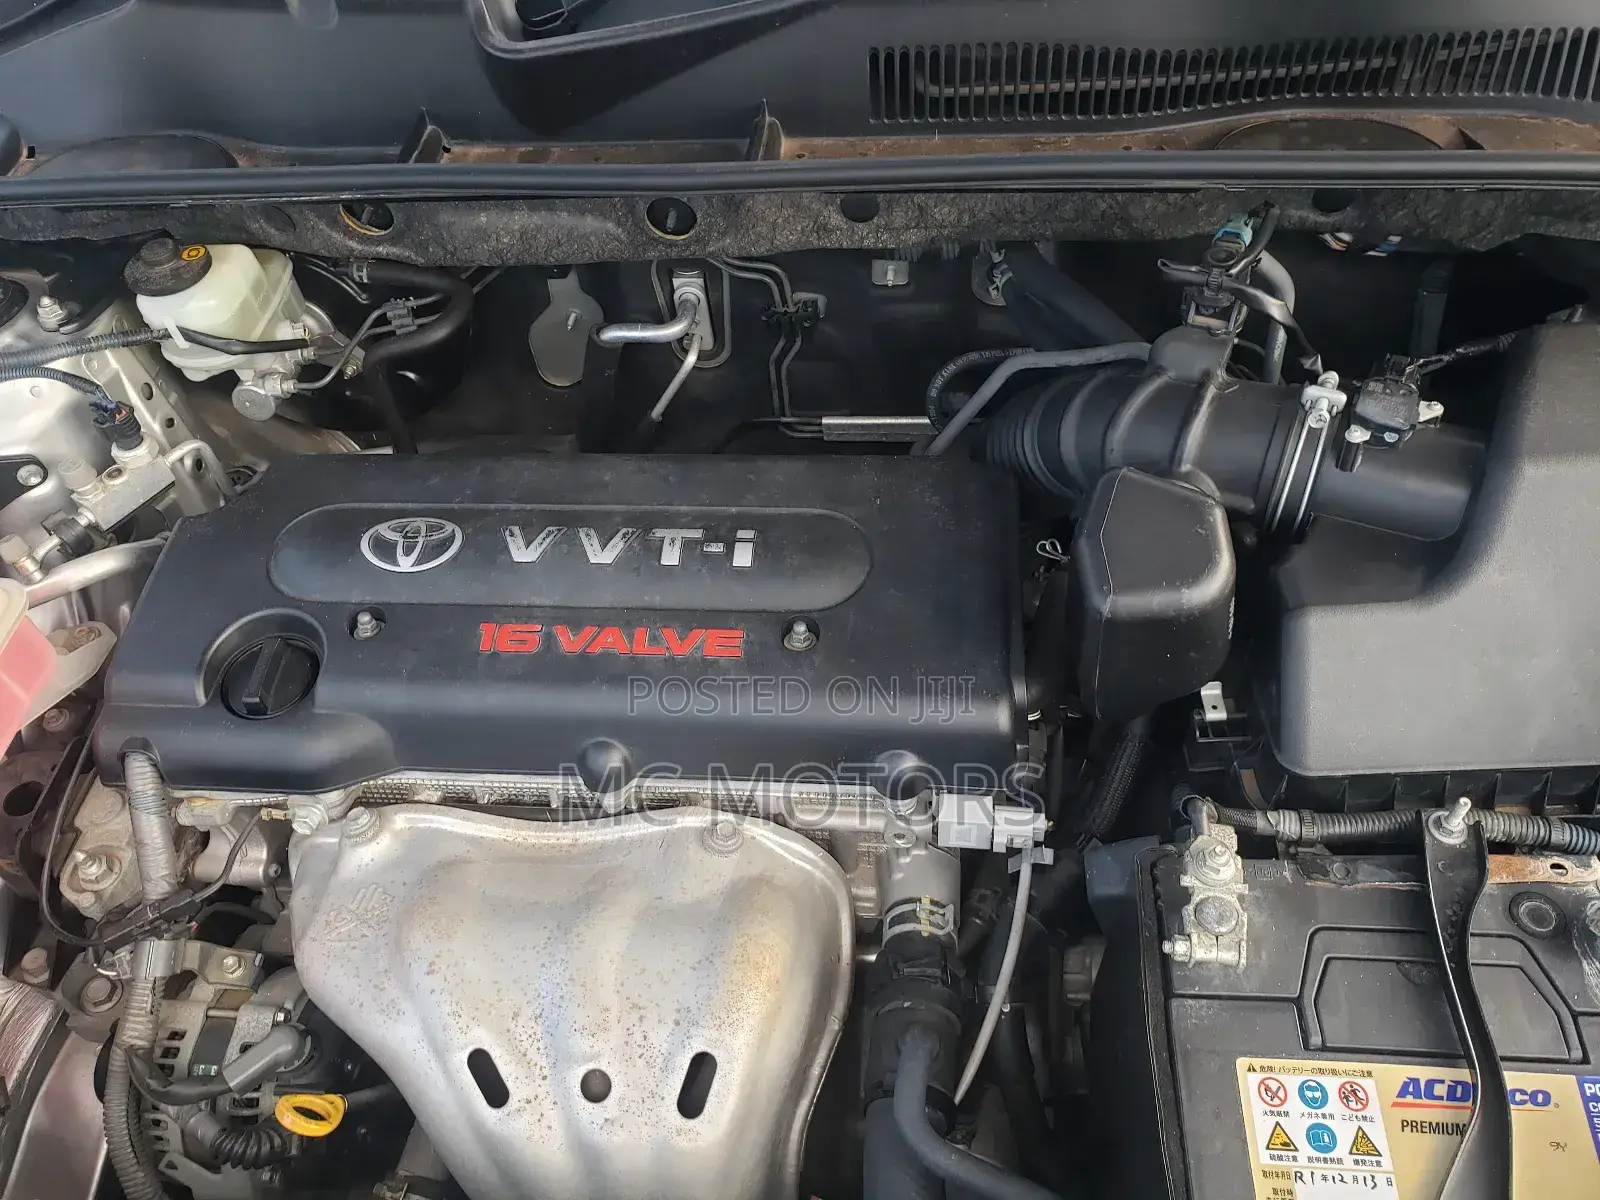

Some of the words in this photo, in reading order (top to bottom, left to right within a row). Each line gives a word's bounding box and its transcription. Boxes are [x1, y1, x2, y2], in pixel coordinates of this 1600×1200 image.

[501, 526, 757, 567] VVT-i
[478, 622, 543, 654] 16
[553, 624, 744, 657] VALVE
[1395, 1076, 1552, 1107] ACDco
[1331, 1173, 1349, 1185] 12
